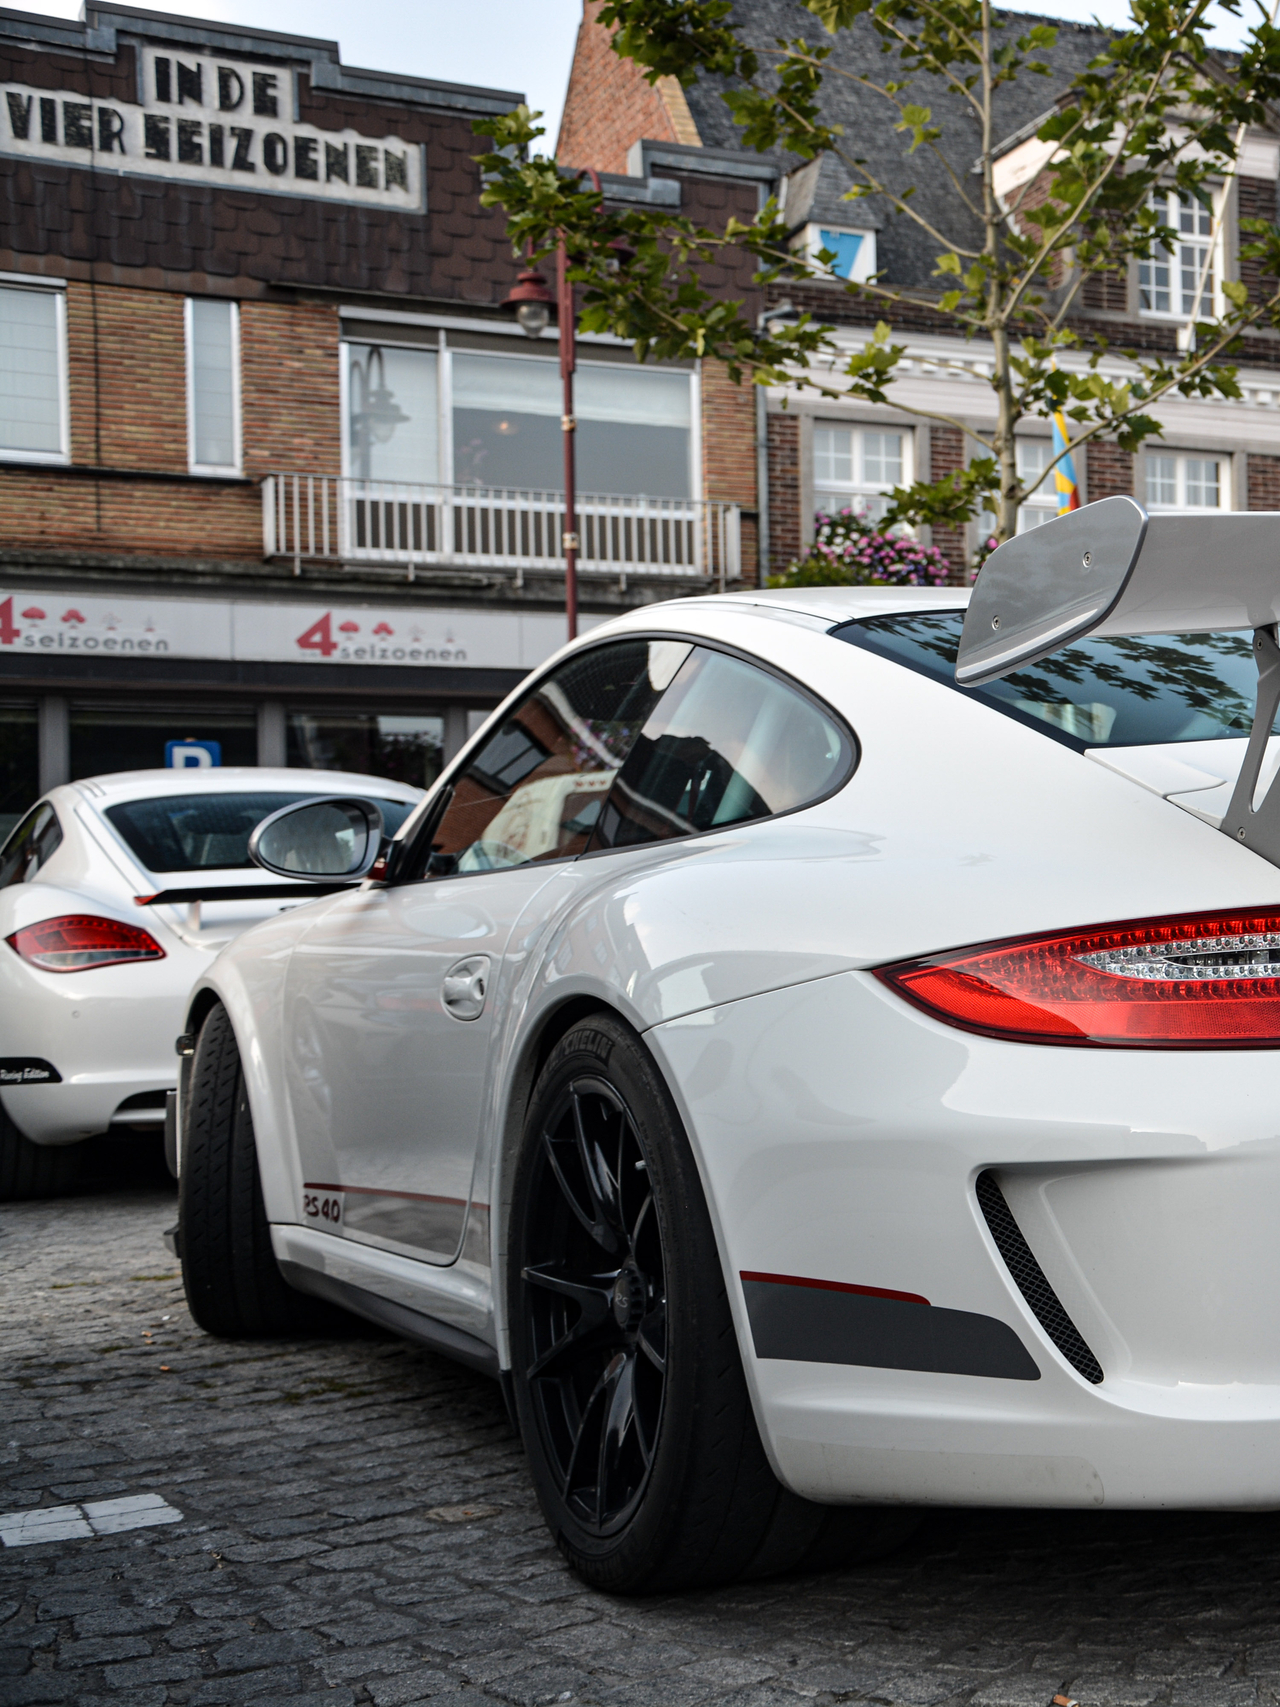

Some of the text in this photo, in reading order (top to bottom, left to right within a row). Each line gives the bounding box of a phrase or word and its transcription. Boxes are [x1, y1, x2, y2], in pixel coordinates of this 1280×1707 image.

[155, 56, 278, 118] IN DE
[6, 91, 408, 193] VIER SEIZOENEN
[24, 632, 169, 651] seizoenen
[296, 611, 467, 661] 4 seizoenen
